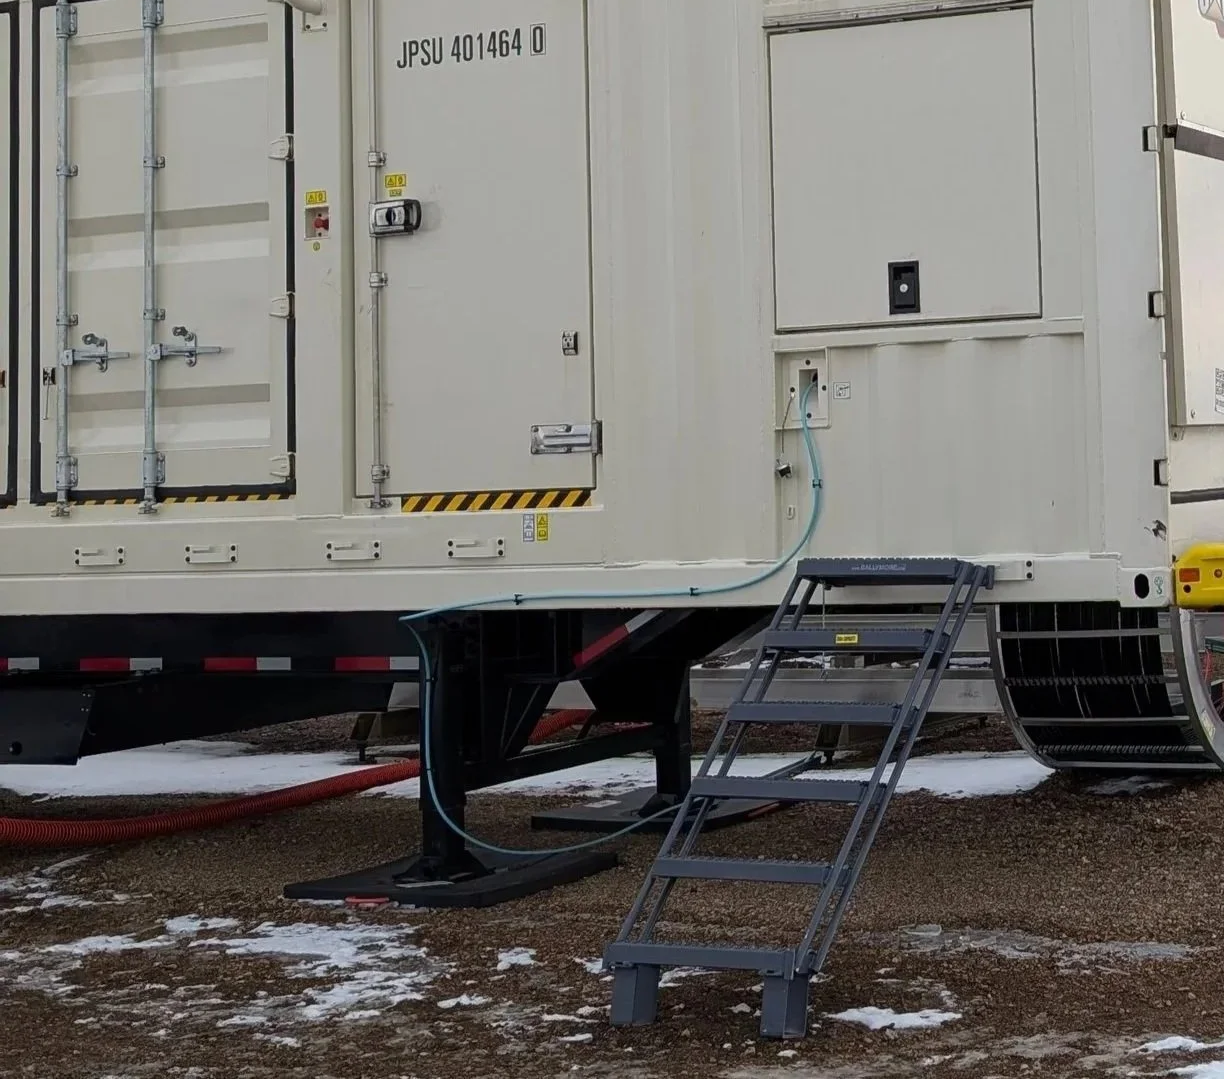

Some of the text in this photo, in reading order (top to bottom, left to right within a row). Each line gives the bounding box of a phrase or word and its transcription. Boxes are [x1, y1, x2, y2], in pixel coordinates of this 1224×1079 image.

[397, 25, 544, 69] JPSU 401464 0
